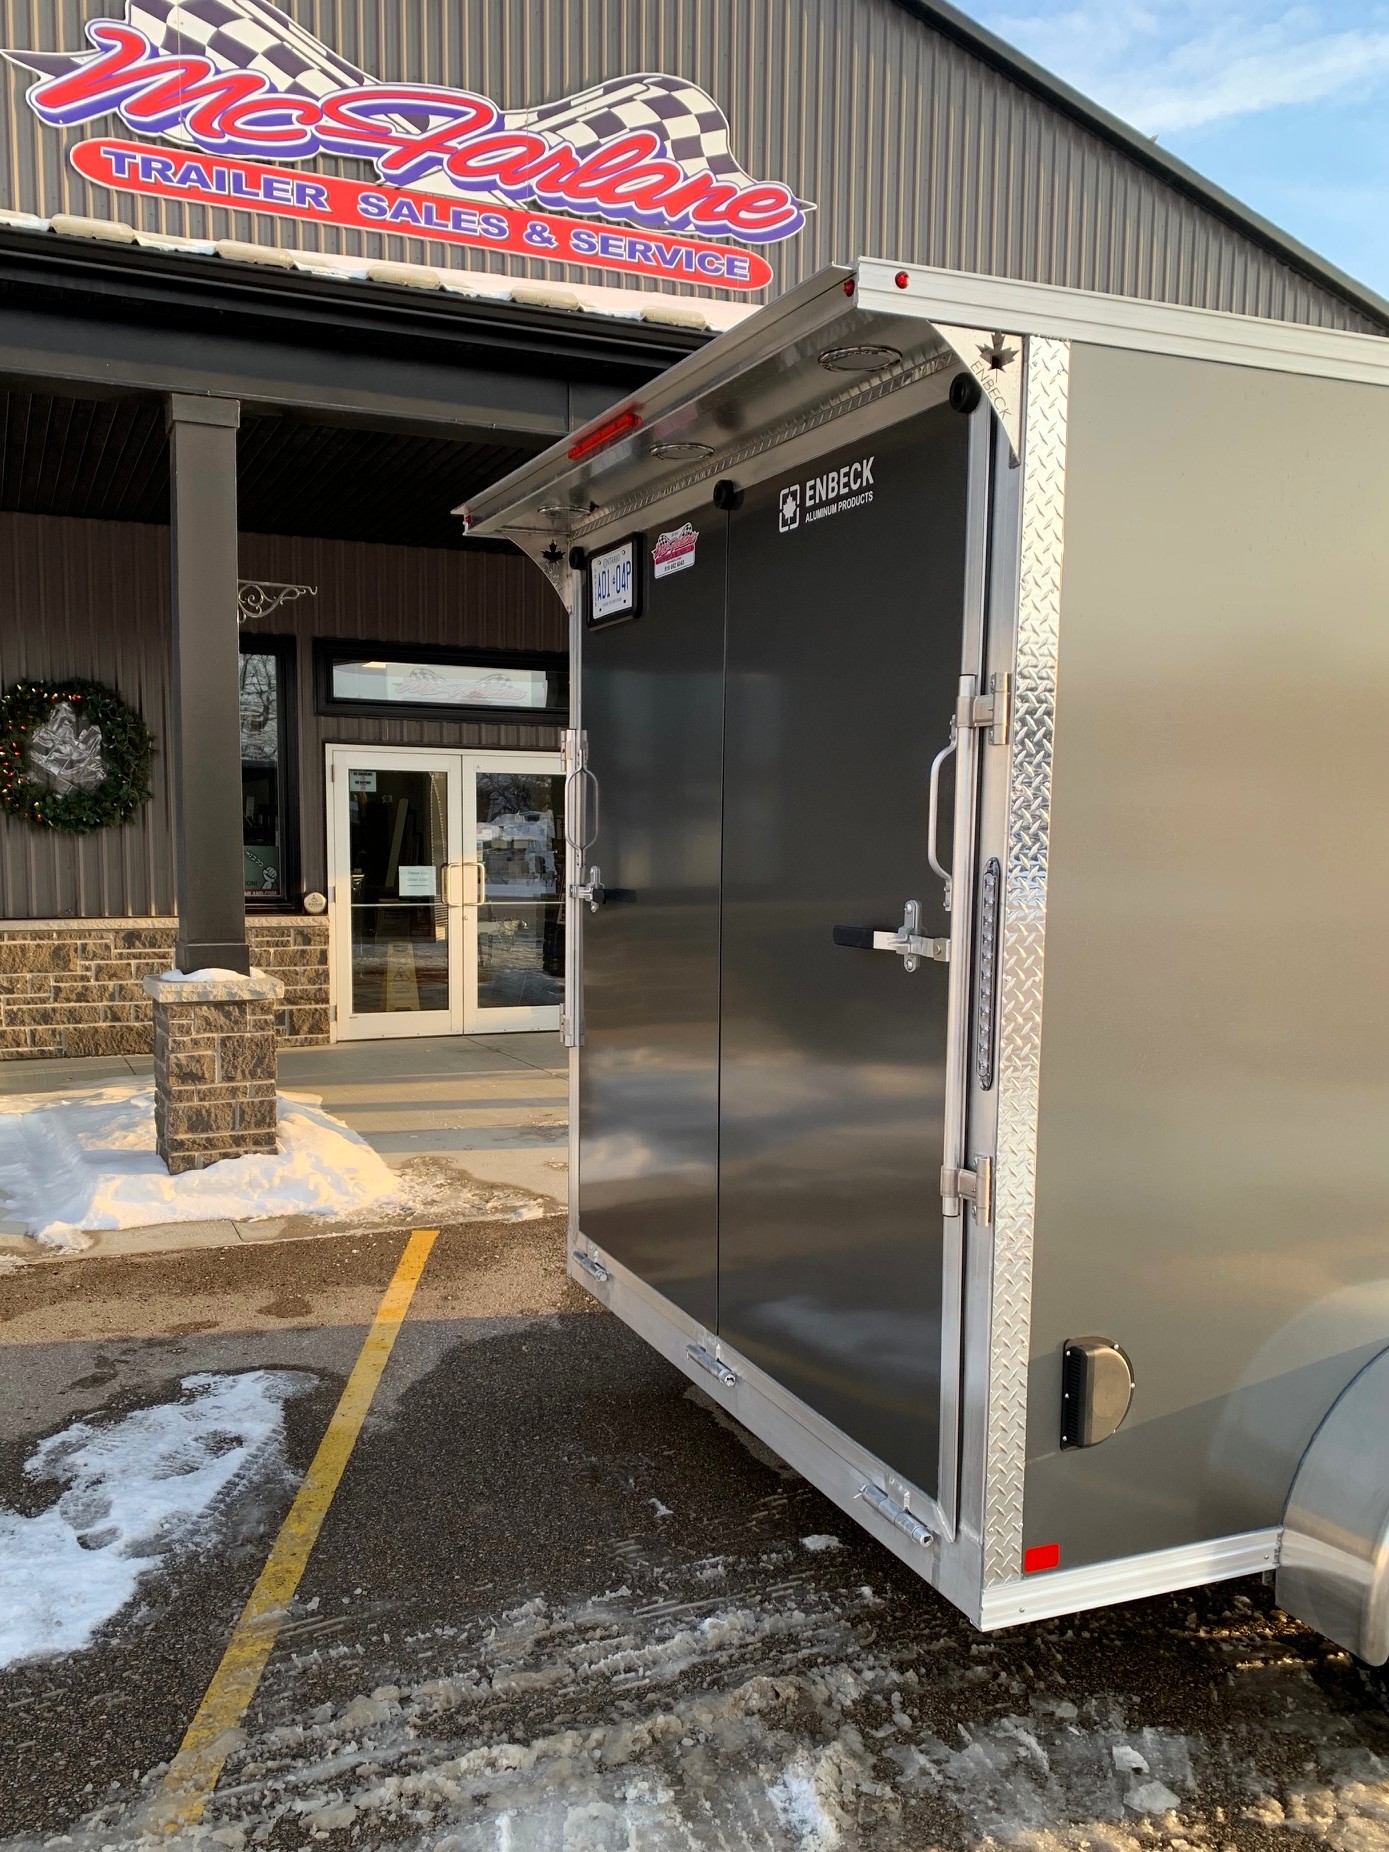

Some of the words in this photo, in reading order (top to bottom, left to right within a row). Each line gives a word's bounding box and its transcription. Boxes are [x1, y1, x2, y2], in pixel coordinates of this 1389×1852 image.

[28, 18, 804, 243] McFarlane
[100, 146, 332, 214] TRAILER
[356, 191, 511, 241] SALES
[522, 220, 559, 252] &
[569, 227, 752, 282] SERVICE
[970, 360, 1012, 420] ENBECK
[804, 502, 838, 523] ALUMINUM
[837, 490, 874, 512] PRODUCTS
[805, 456, 875, 507] ENBECK
